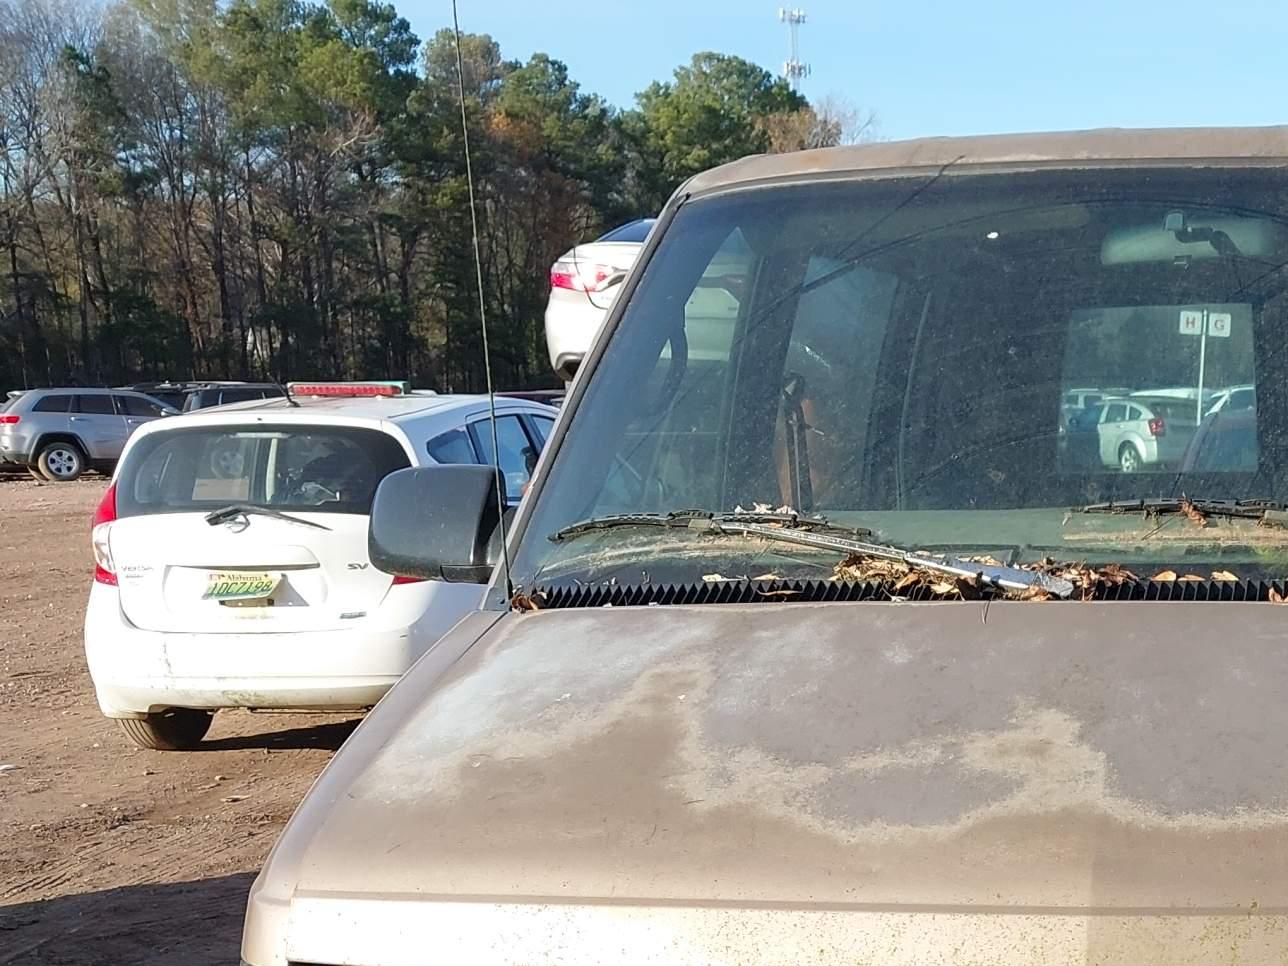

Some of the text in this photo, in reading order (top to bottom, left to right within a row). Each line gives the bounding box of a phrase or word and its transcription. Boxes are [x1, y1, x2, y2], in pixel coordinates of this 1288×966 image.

[1185, 316, 1196, 329] H
[1214, 319, 1225, 331] G
[226, 573, 262, 582] Alabama
